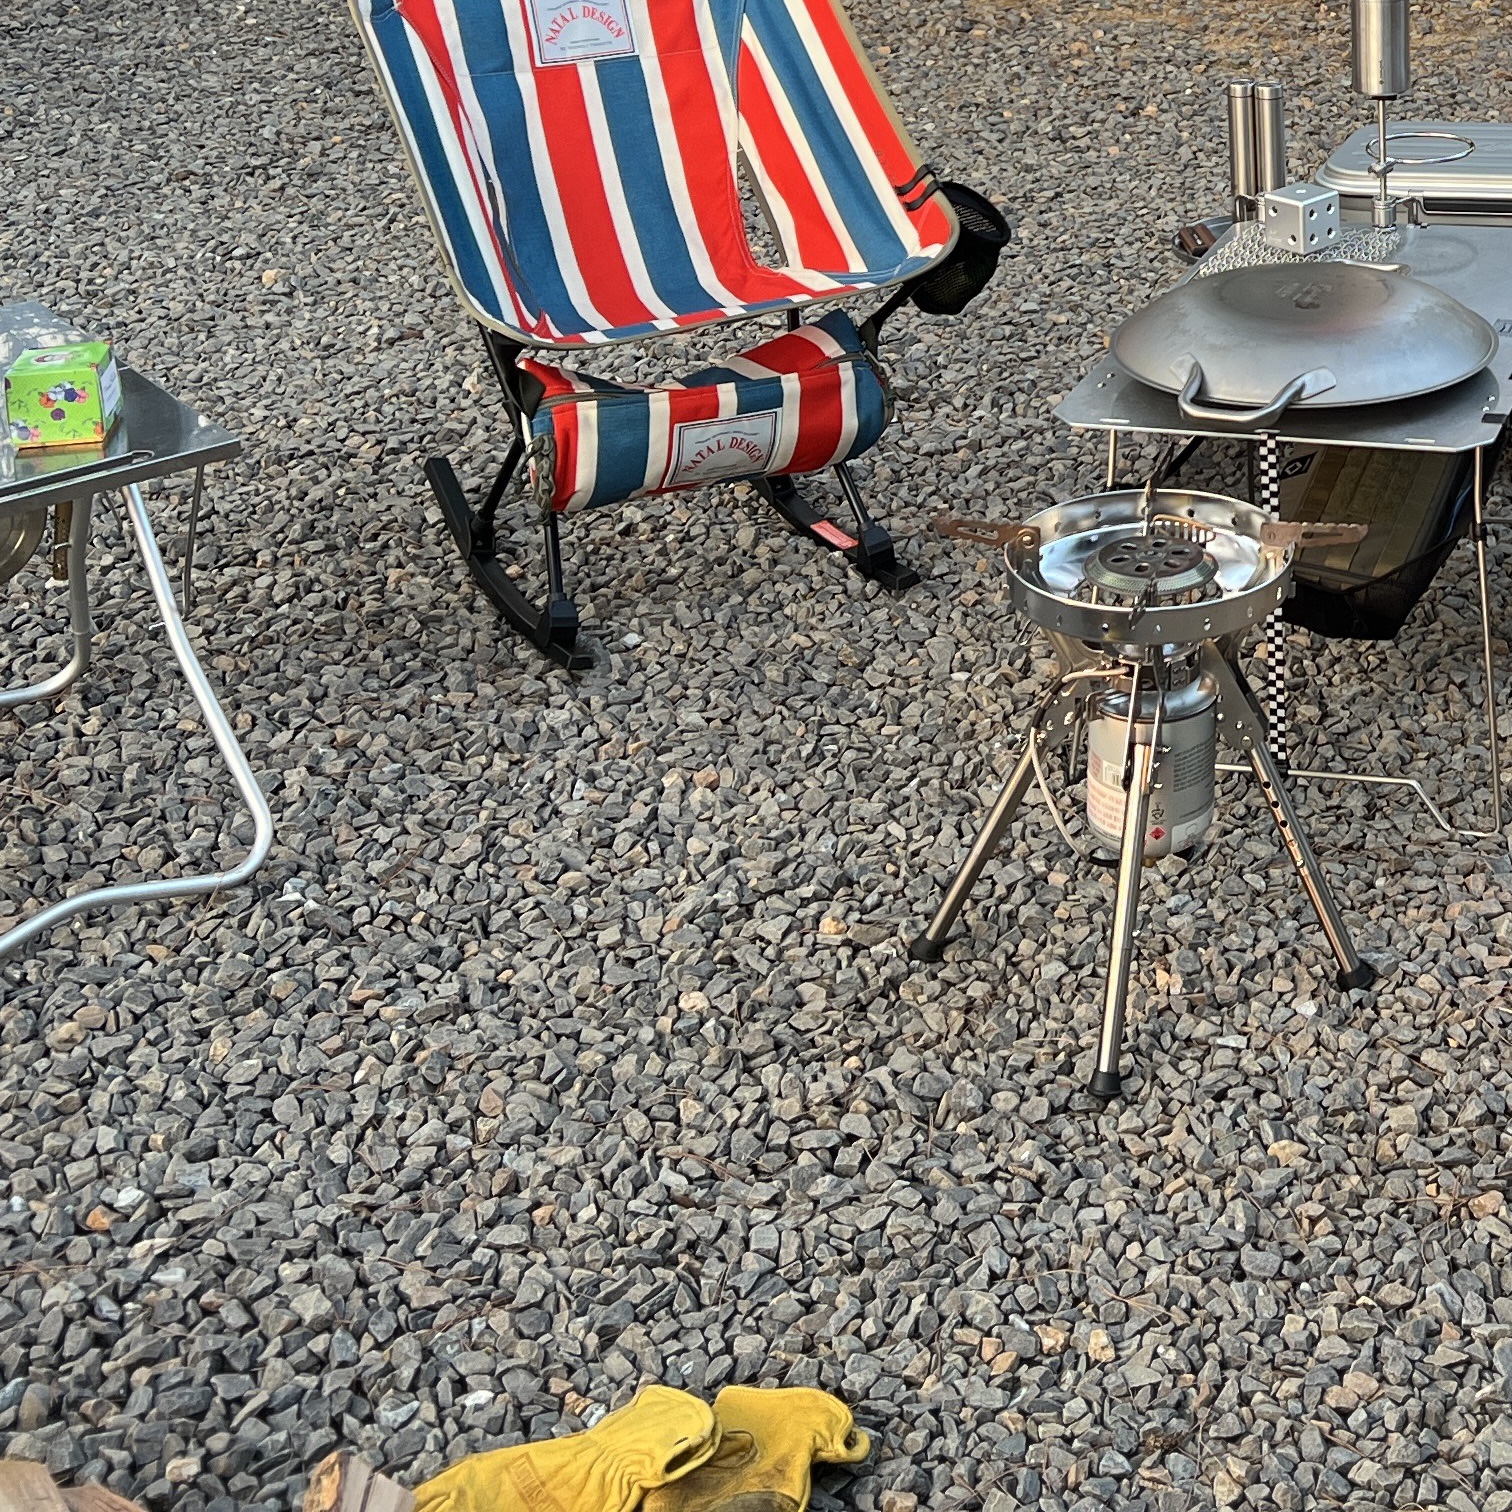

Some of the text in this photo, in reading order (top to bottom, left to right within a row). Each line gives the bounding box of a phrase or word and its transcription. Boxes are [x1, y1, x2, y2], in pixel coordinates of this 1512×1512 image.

[545, 5, 625, 45] NATAL DESIGN
[682, 439, 725, 473] NATAL
[728, 436, 765, 464] DESIGN
